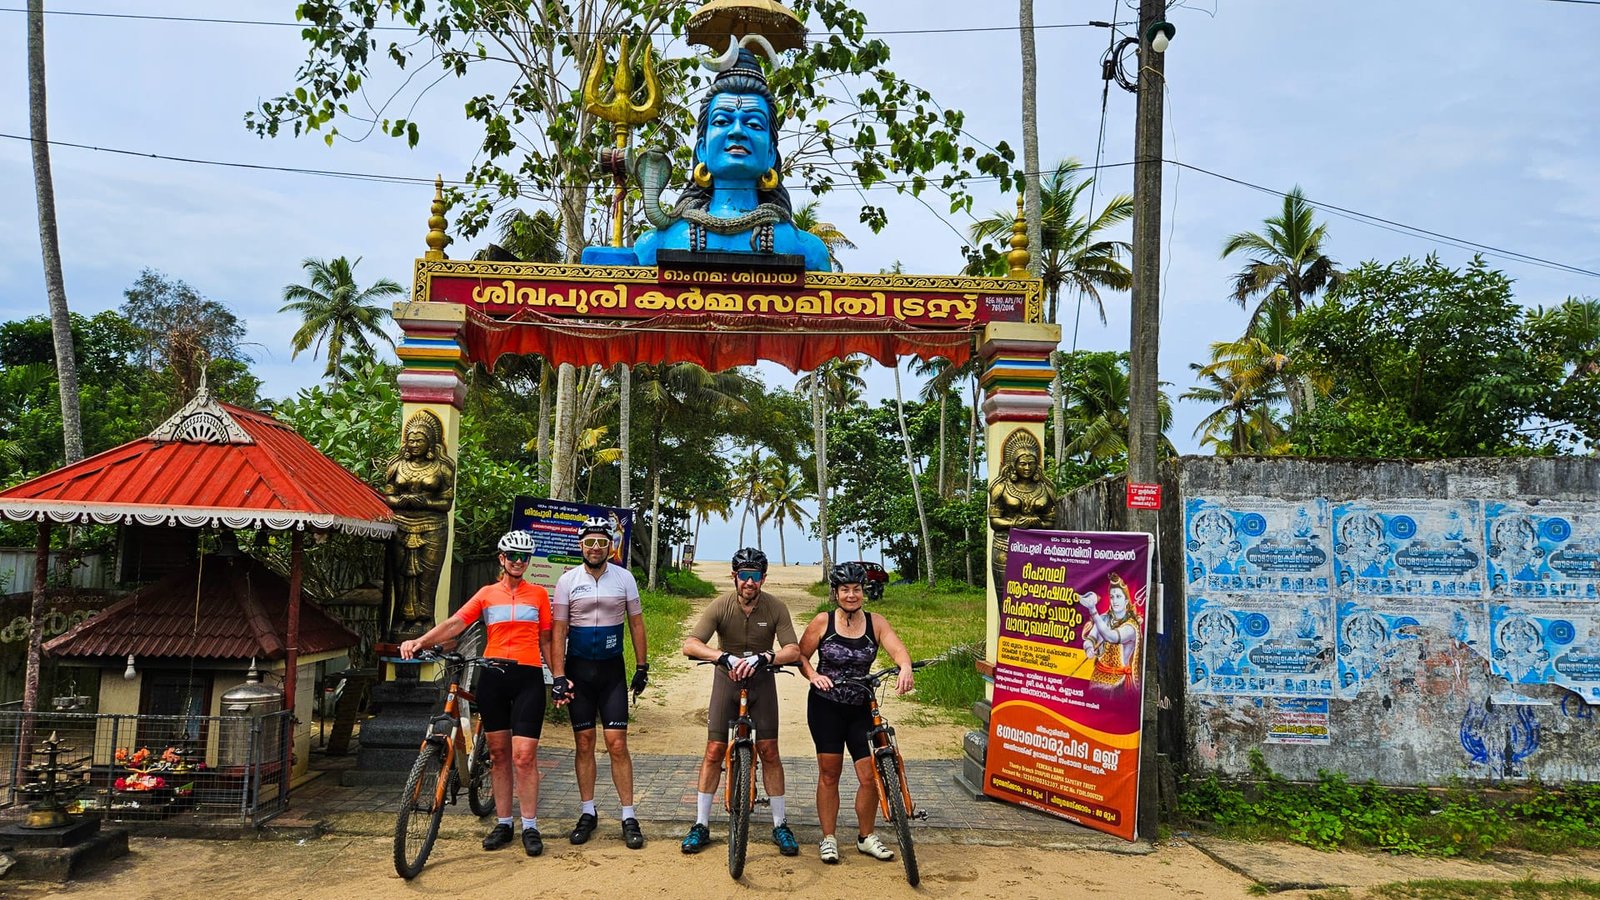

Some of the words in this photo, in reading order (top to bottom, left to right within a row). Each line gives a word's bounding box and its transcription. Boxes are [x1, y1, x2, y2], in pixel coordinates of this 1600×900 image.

[732, 271, 797, 284] ശിവായ
[472, 280, 627, 314] ശിവപുരി
[1010, 541, 1042, 556] ശിവപുരി
[1022, 562, 1066, 584] ദീപാവലി
[1006, 580, 1079, 605] ആഘോഷവും
